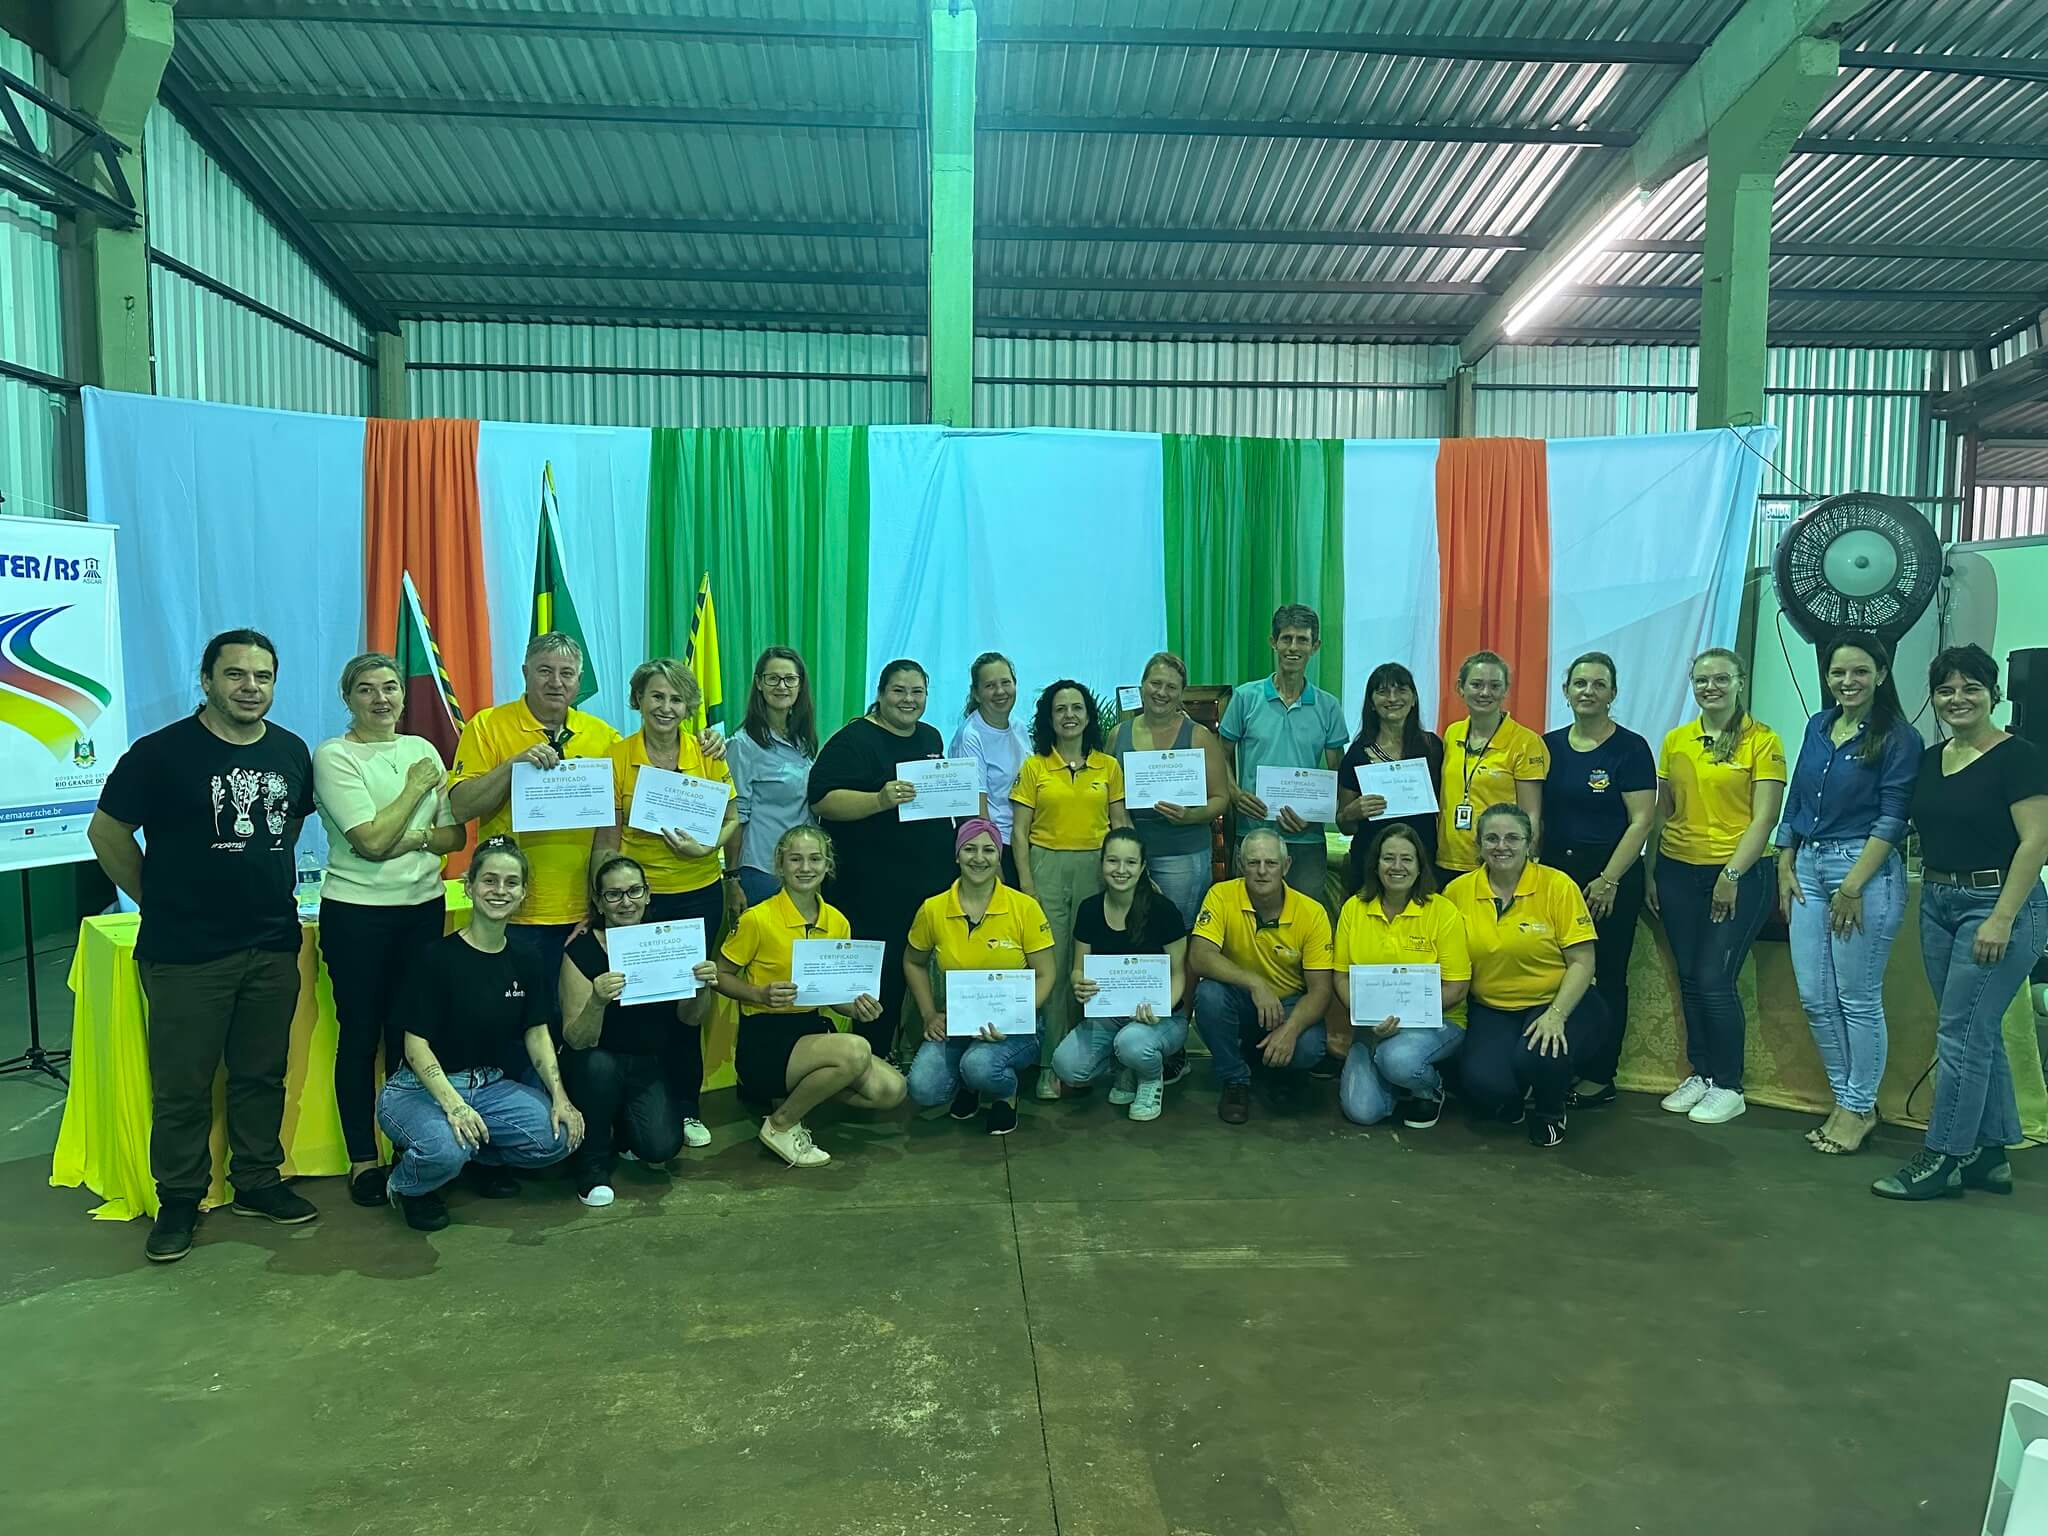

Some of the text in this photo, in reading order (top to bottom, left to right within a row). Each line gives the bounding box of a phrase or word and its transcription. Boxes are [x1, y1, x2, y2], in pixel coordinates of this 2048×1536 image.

[68, 779, 94, 787] GRANDE
[542, 775, 587, 783] CERTIFICADO
[664, 786, 704, 799] CERTIFICADO
[640, 937, 681, 947] CERTIFICADO
